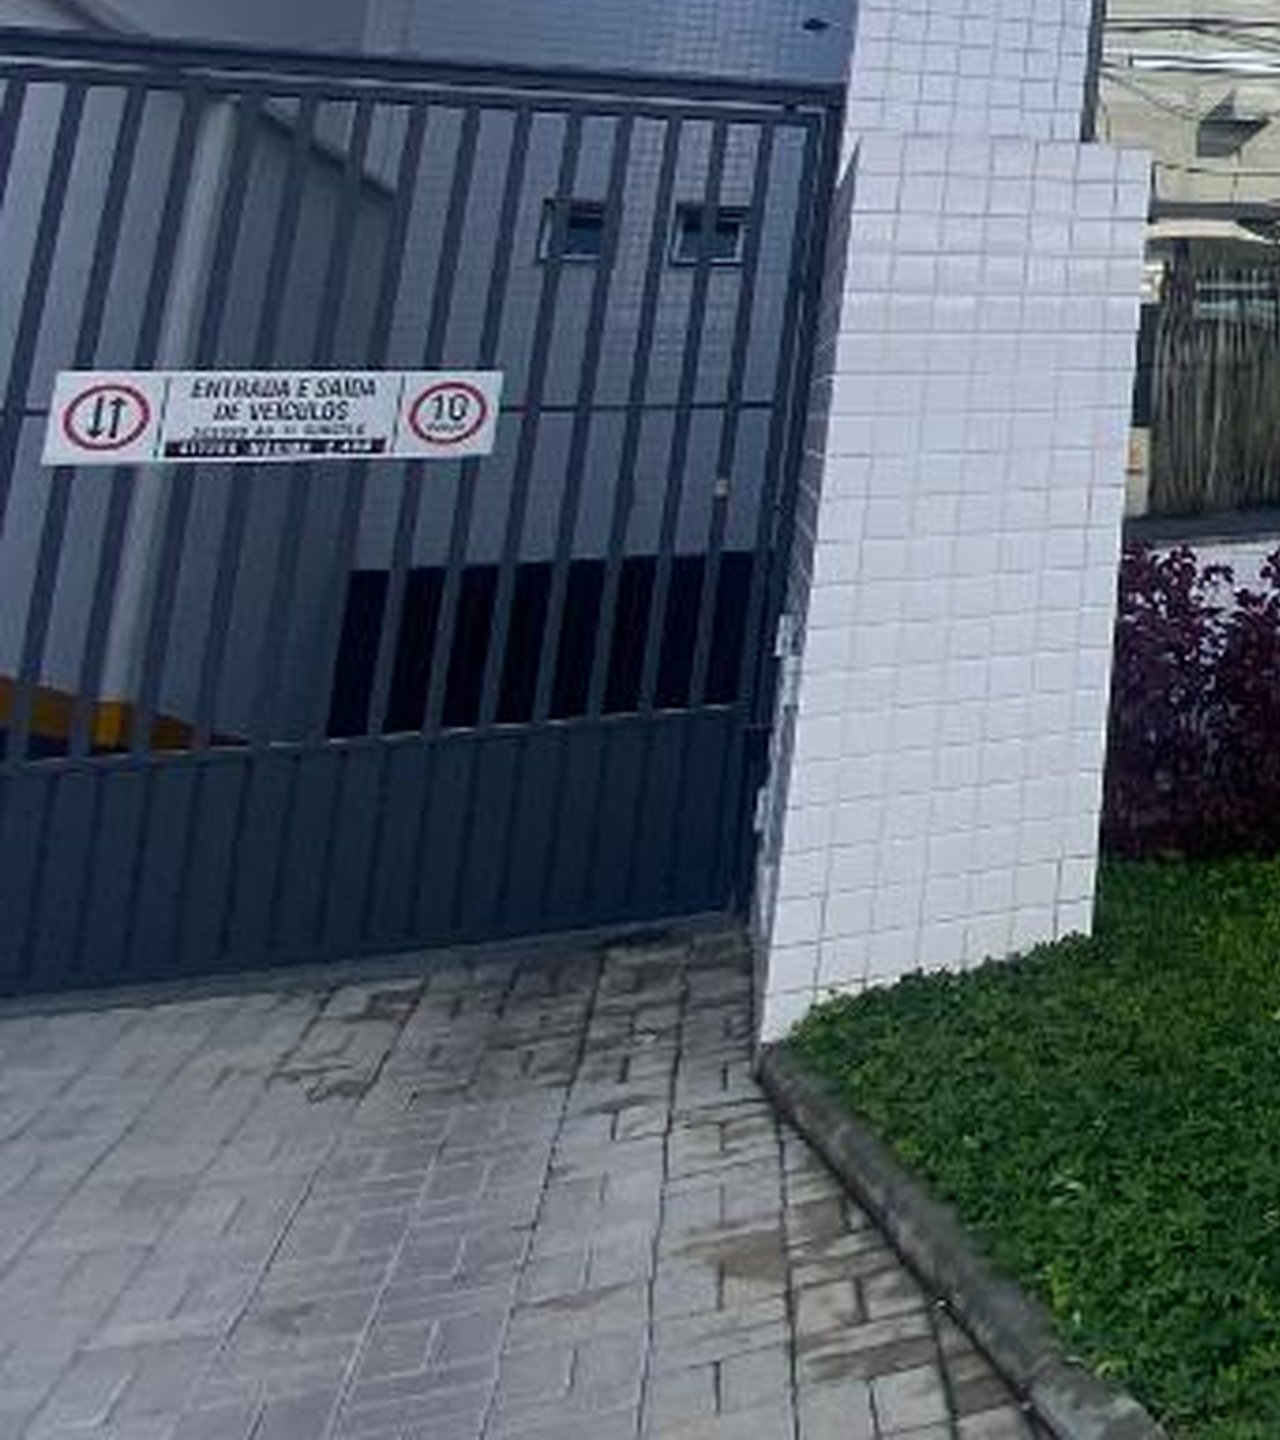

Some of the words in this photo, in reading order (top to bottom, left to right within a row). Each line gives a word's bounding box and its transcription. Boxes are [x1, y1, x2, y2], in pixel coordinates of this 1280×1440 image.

[191, 377, 290, 399] ENTRADA
[297, 377, 311, 398] E
[213, 400, 243, 421] DE
[431, 393, 470, 421] 10
